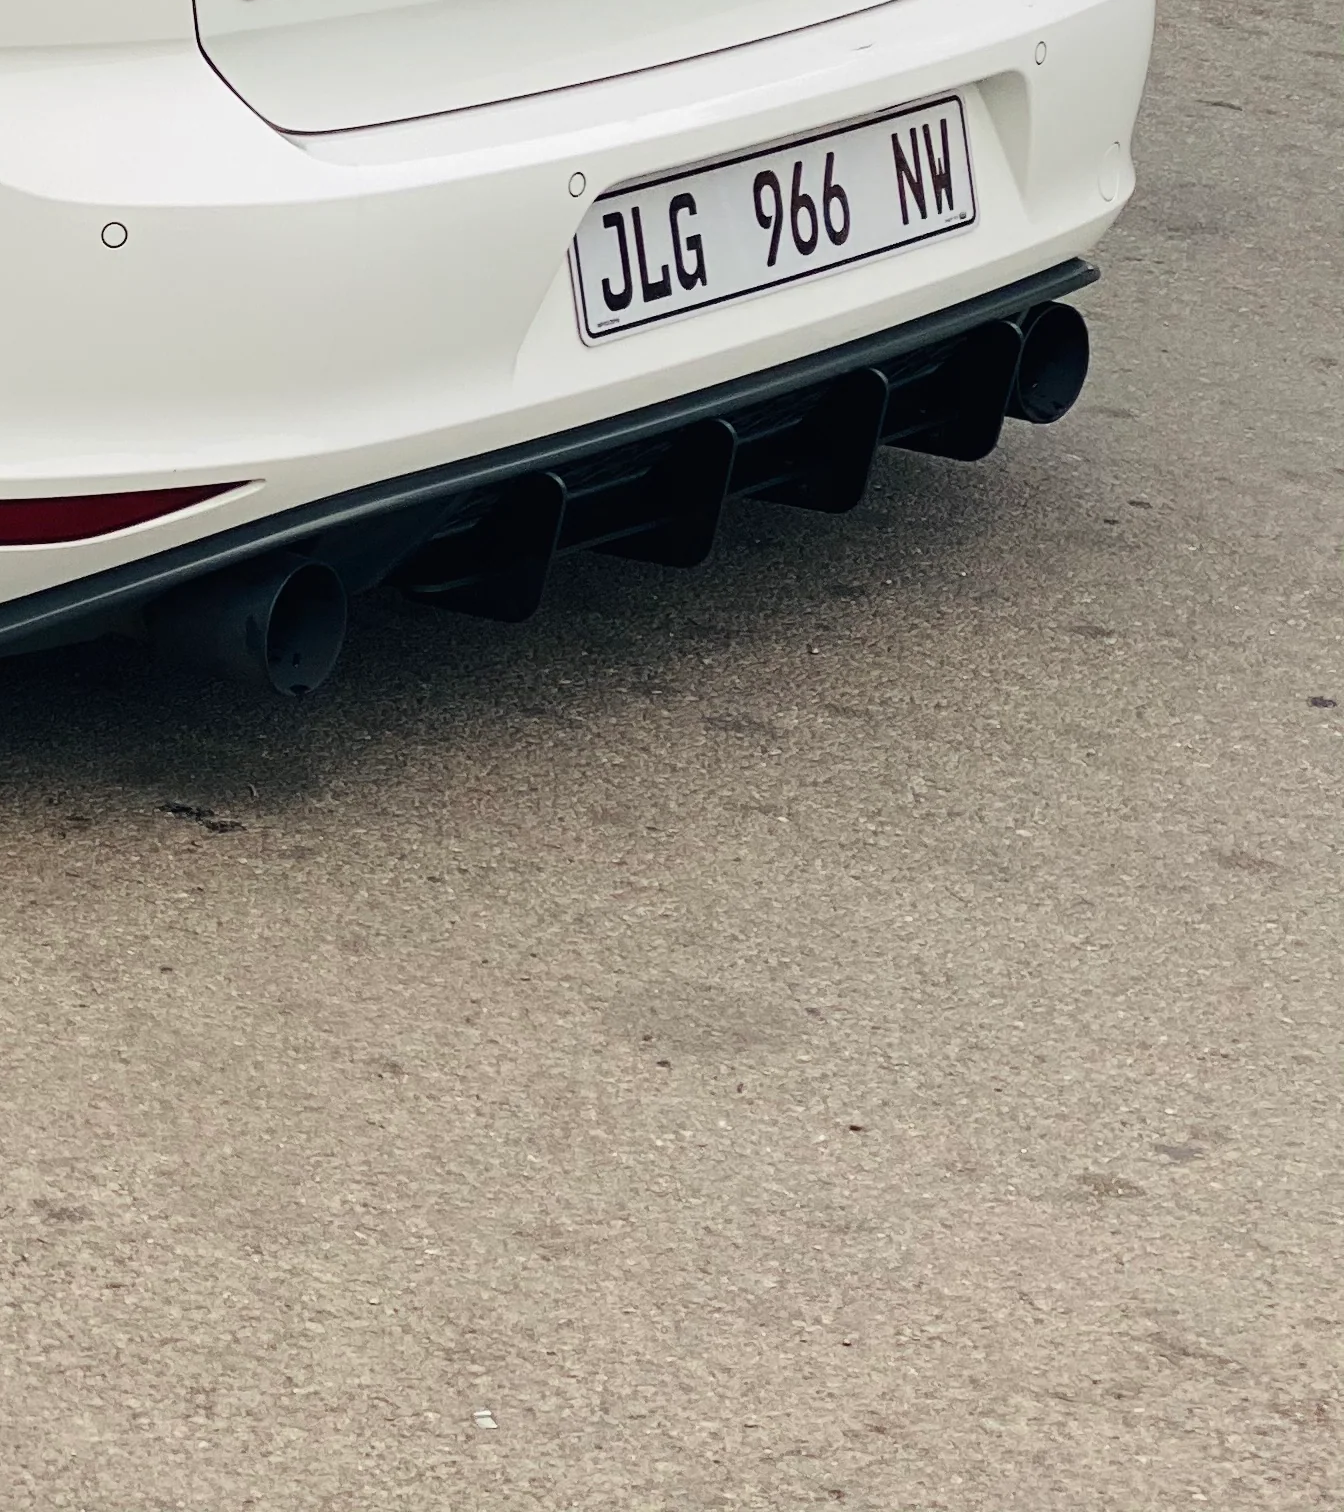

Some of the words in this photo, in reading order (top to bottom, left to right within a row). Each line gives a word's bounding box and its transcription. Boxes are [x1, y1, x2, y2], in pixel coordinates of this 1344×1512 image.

[601, 192, 707, 312] JLG
[752, 151, 850, 267] 966
[891, 118, 954, 225] NW
